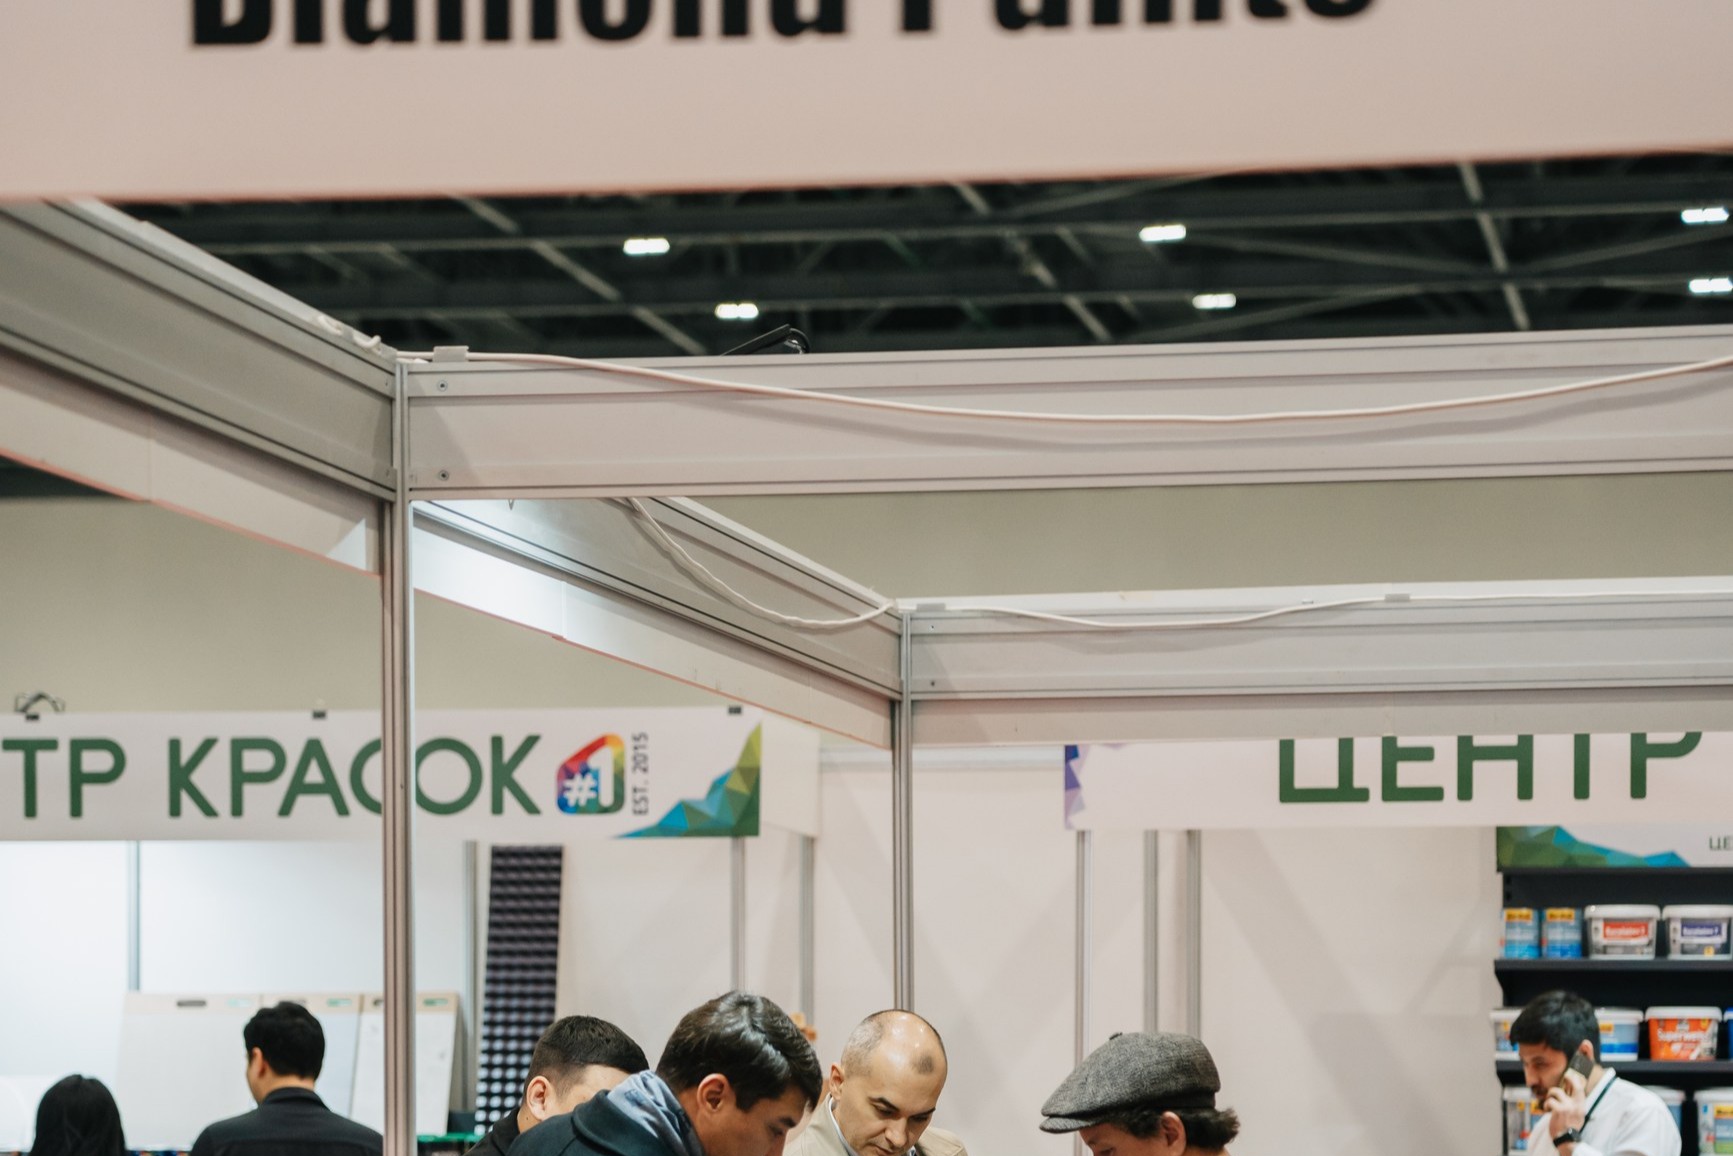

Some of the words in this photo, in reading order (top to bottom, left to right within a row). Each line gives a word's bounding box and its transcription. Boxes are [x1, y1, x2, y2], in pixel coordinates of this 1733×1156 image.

[1, 737, 127, 818] ТР
[168, 736, 542, 817] КРАСОК
[631, 731, 649, 774] 2015
